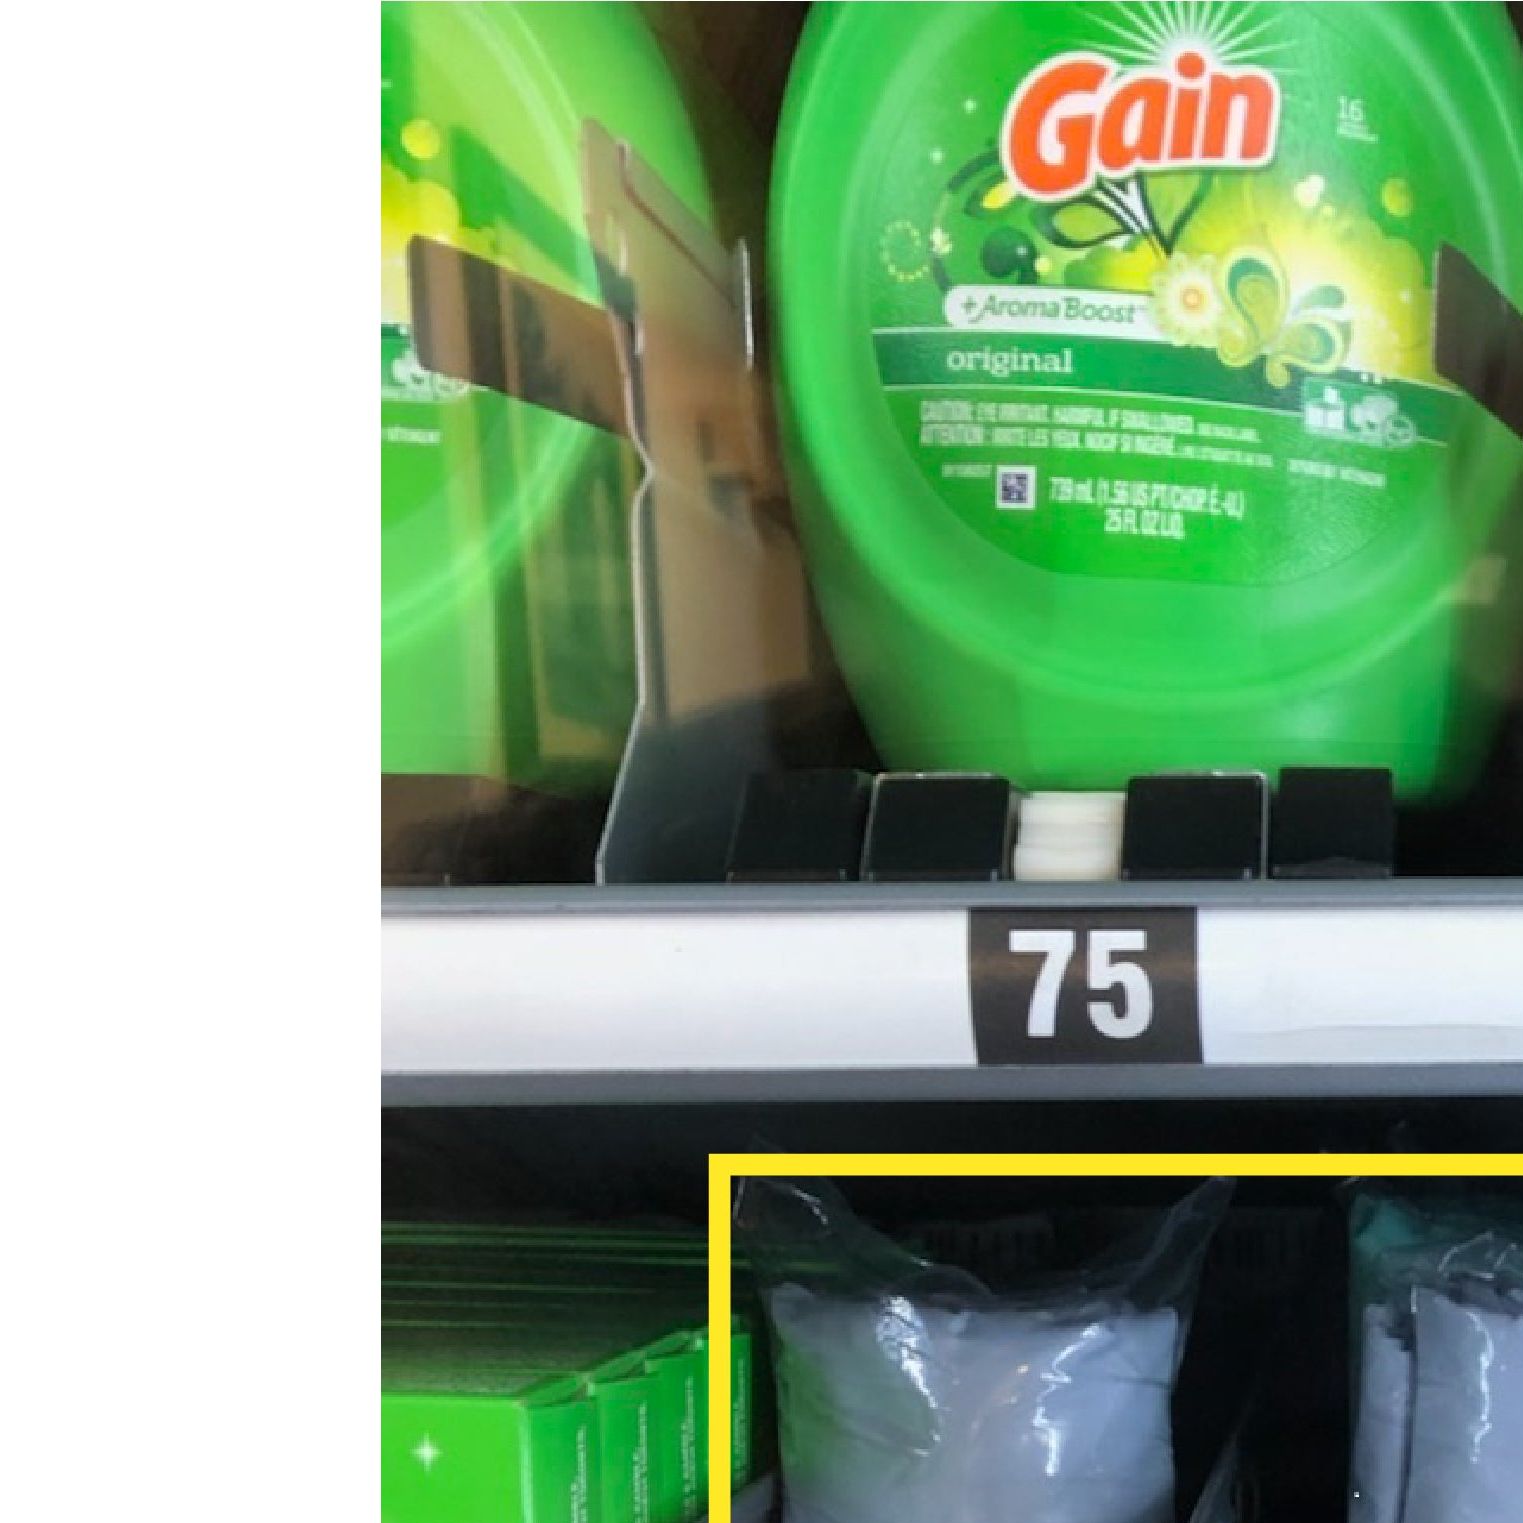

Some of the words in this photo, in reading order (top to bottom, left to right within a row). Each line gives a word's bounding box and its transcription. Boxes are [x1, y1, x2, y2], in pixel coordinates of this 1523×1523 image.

[1003, 47, 1279, 200] Gain
[946, 346, 1074, 377] original
[1007, 928, 1156, 1041] 75
